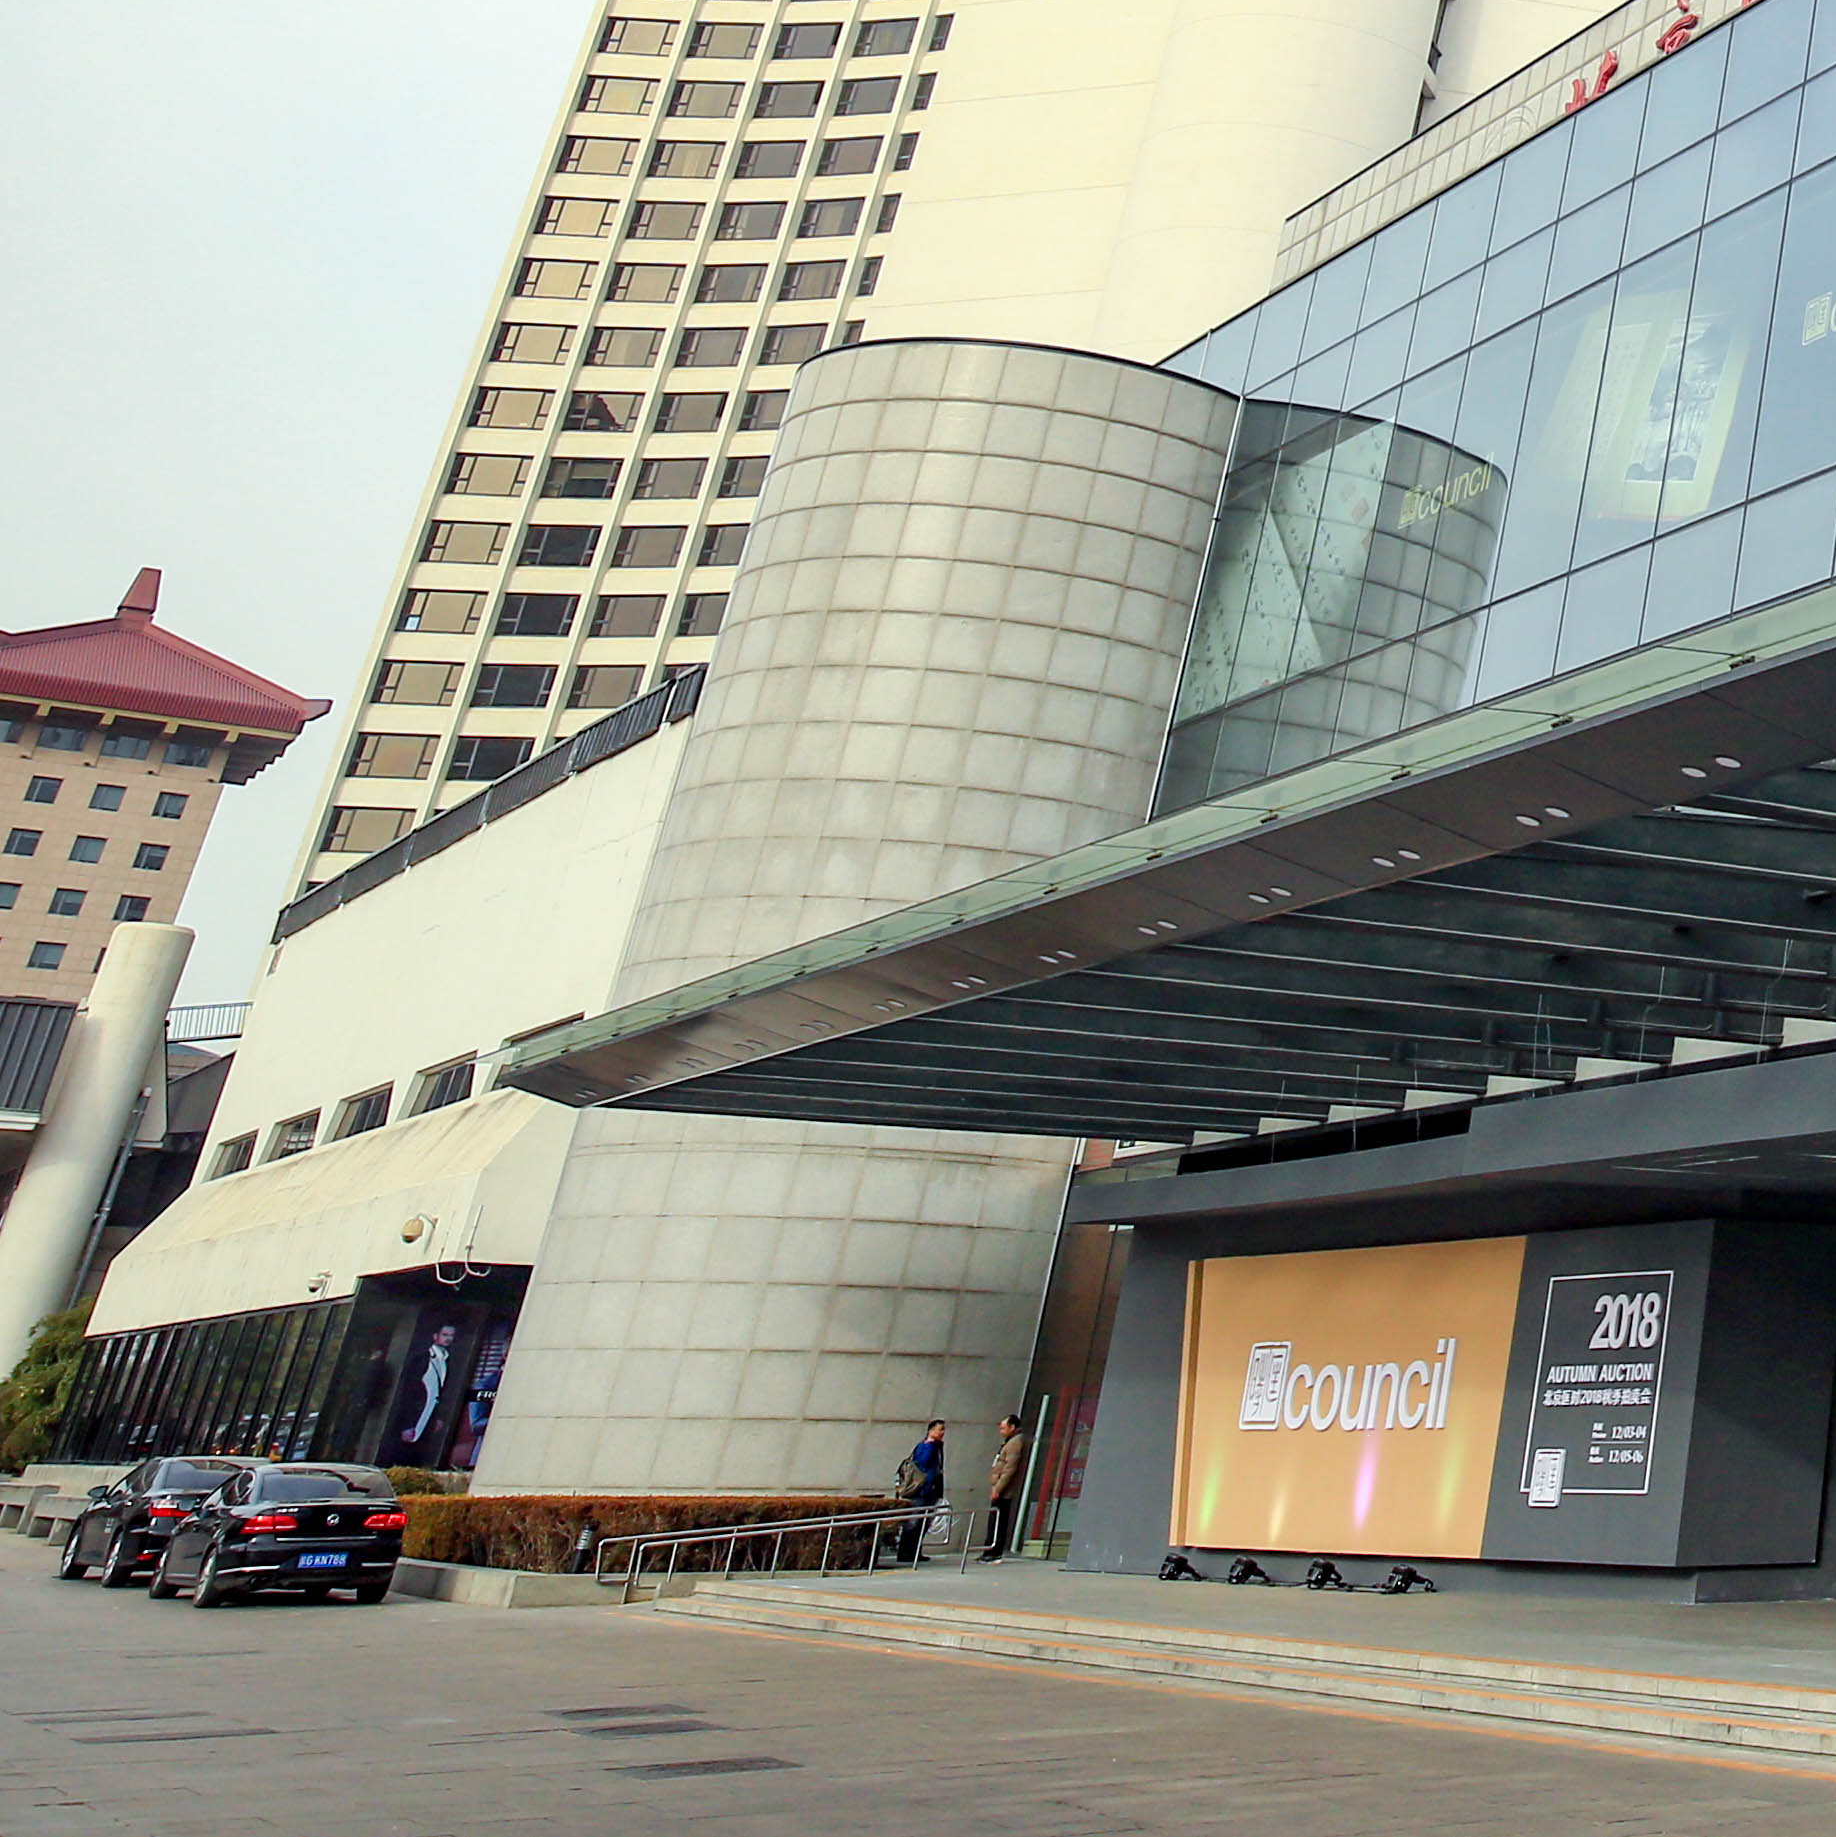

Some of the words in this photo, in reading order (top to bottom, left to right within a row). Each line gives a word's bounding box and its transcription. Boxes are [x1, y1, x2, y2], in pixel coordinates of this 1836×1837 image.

[1588, 1291, 1663, 1351] 2018
[1283, 1337, 1457, 1432] council
[1546, 1364, 1598, 1383] AUTUMN
[1598, 1362, 1655, 1382] AUCTION
